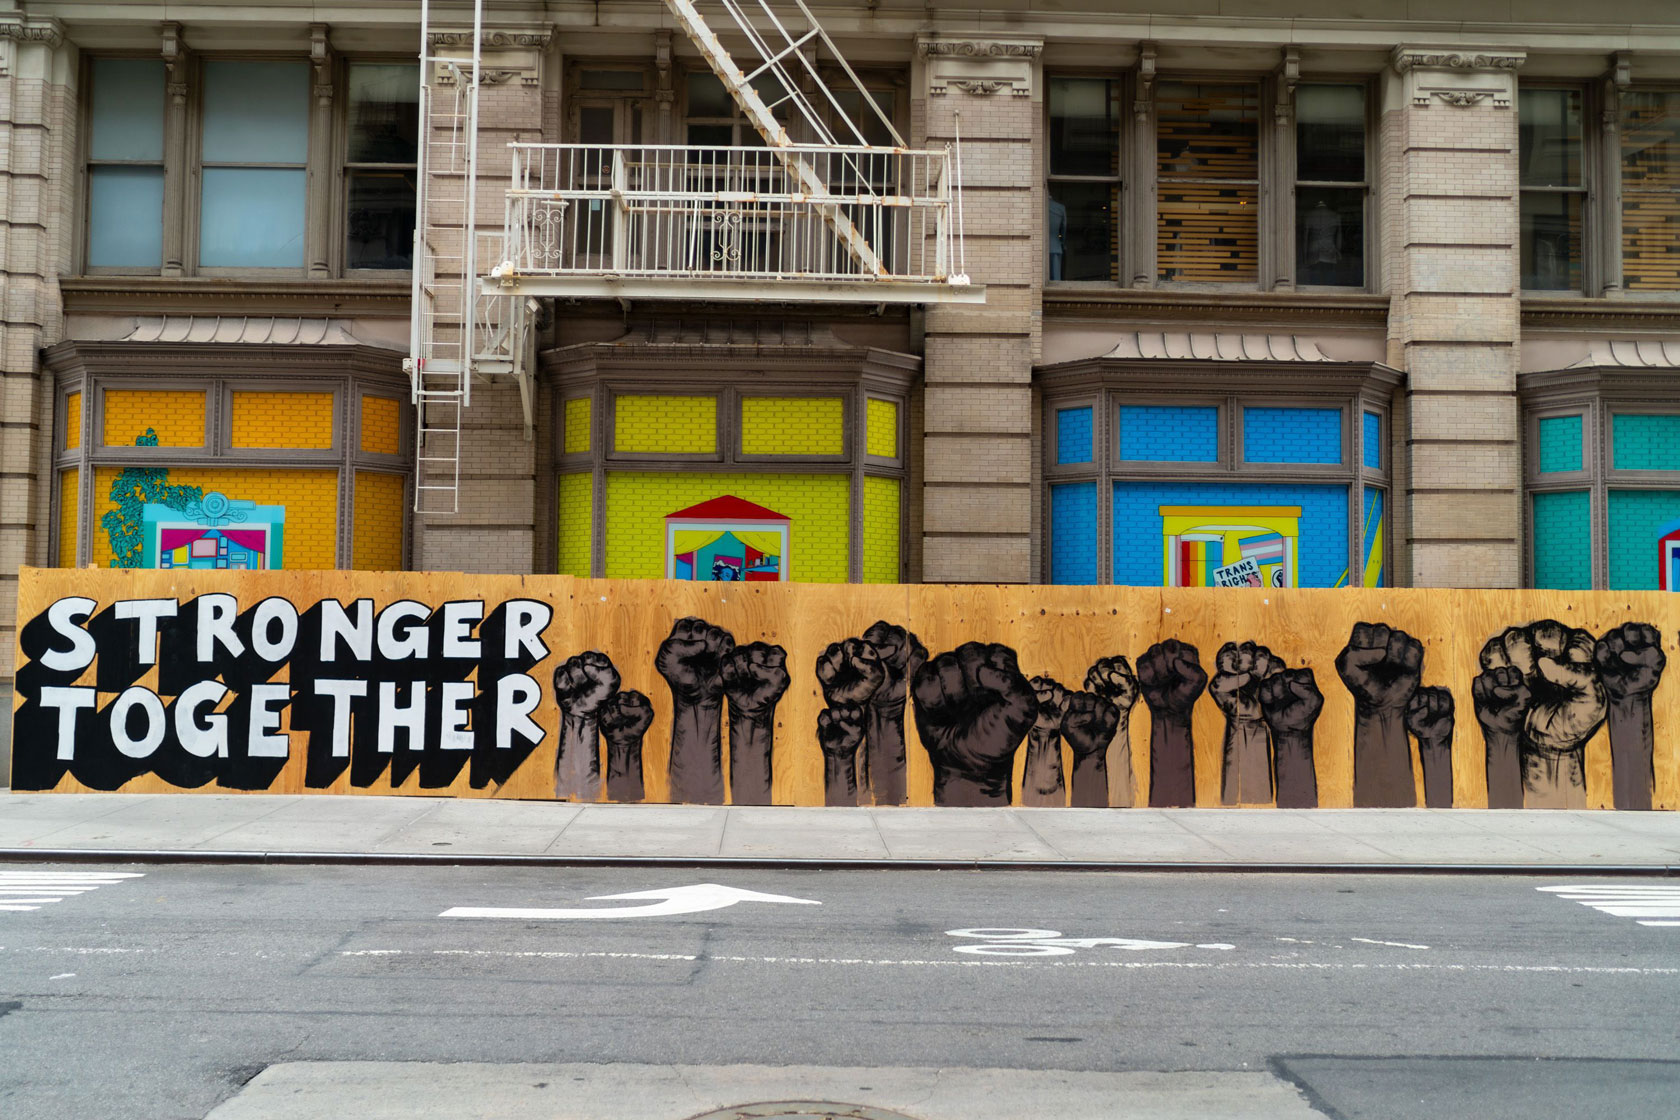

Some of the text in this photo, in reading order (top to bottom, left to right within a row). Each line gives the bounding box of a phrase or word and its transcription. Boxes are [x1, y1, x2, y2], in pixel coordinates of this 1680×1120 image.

[1216, 561, 1254, 579] TRANS
[39, 593, 553, 671] STRONGER
[39, 673, 548, 760] TOGETHER
